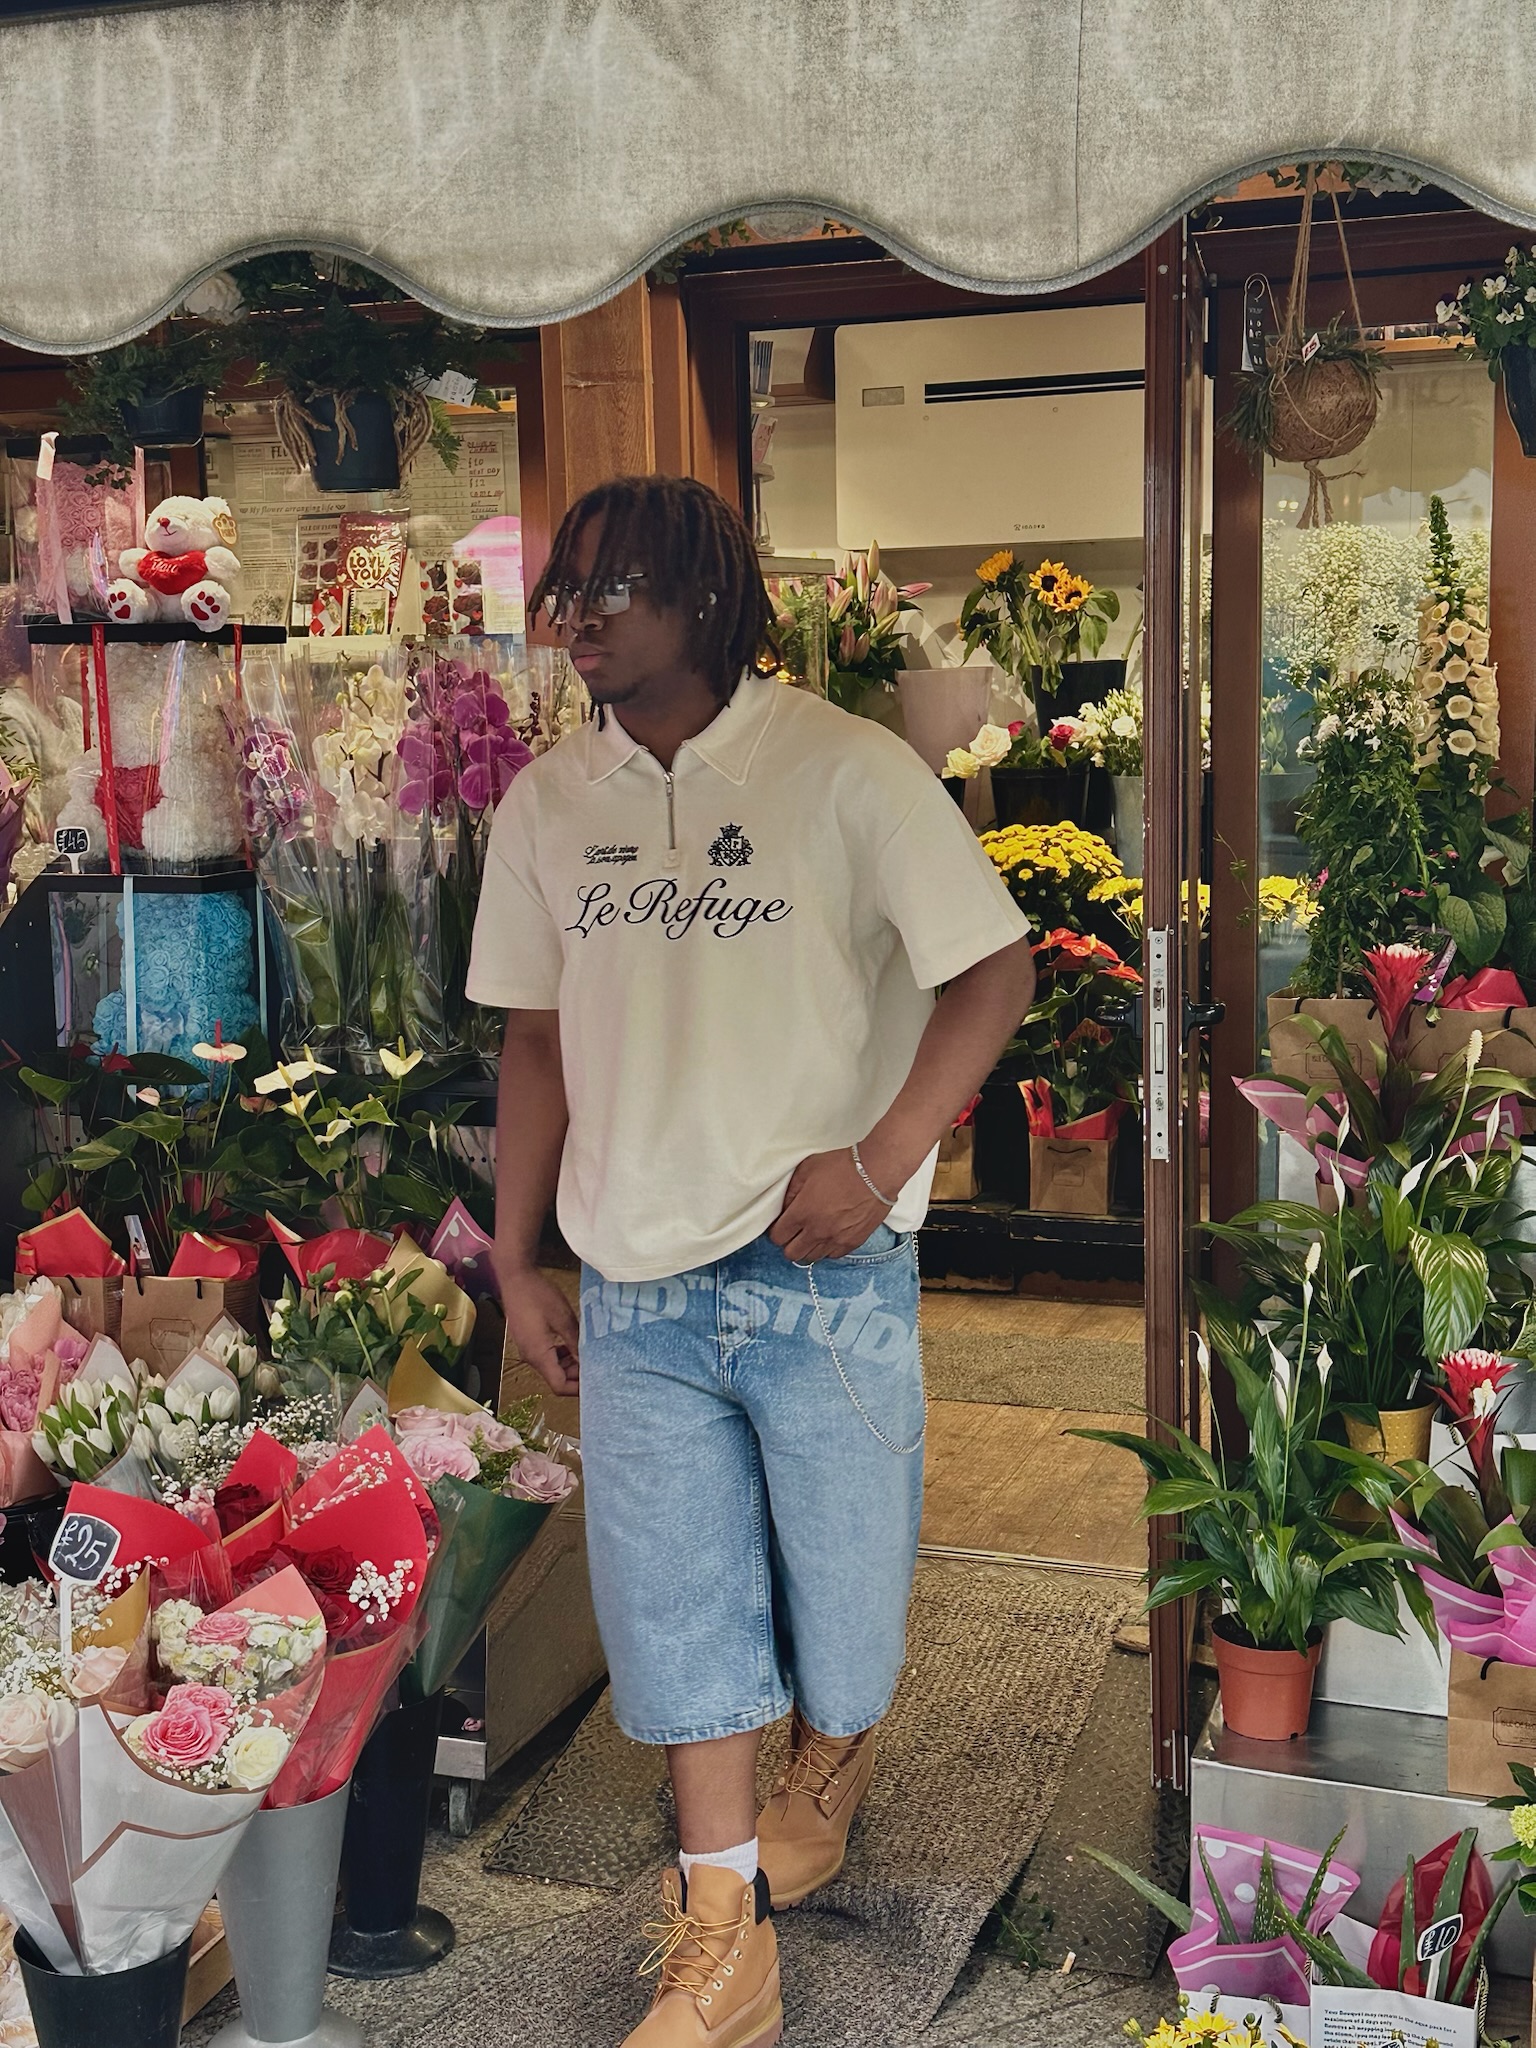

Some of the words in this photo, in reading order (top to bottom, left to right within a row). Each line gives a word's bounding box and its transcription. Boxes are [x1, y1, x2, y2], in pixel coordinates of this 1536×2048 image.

[350, 569, 382, 581] YOU
[565, 883, 620, 939] Le
[623, 878, 794, 940] Refuge
[57, 1520, 107, 1571] £25
[1423, 1926, 1457, 1958] £10
